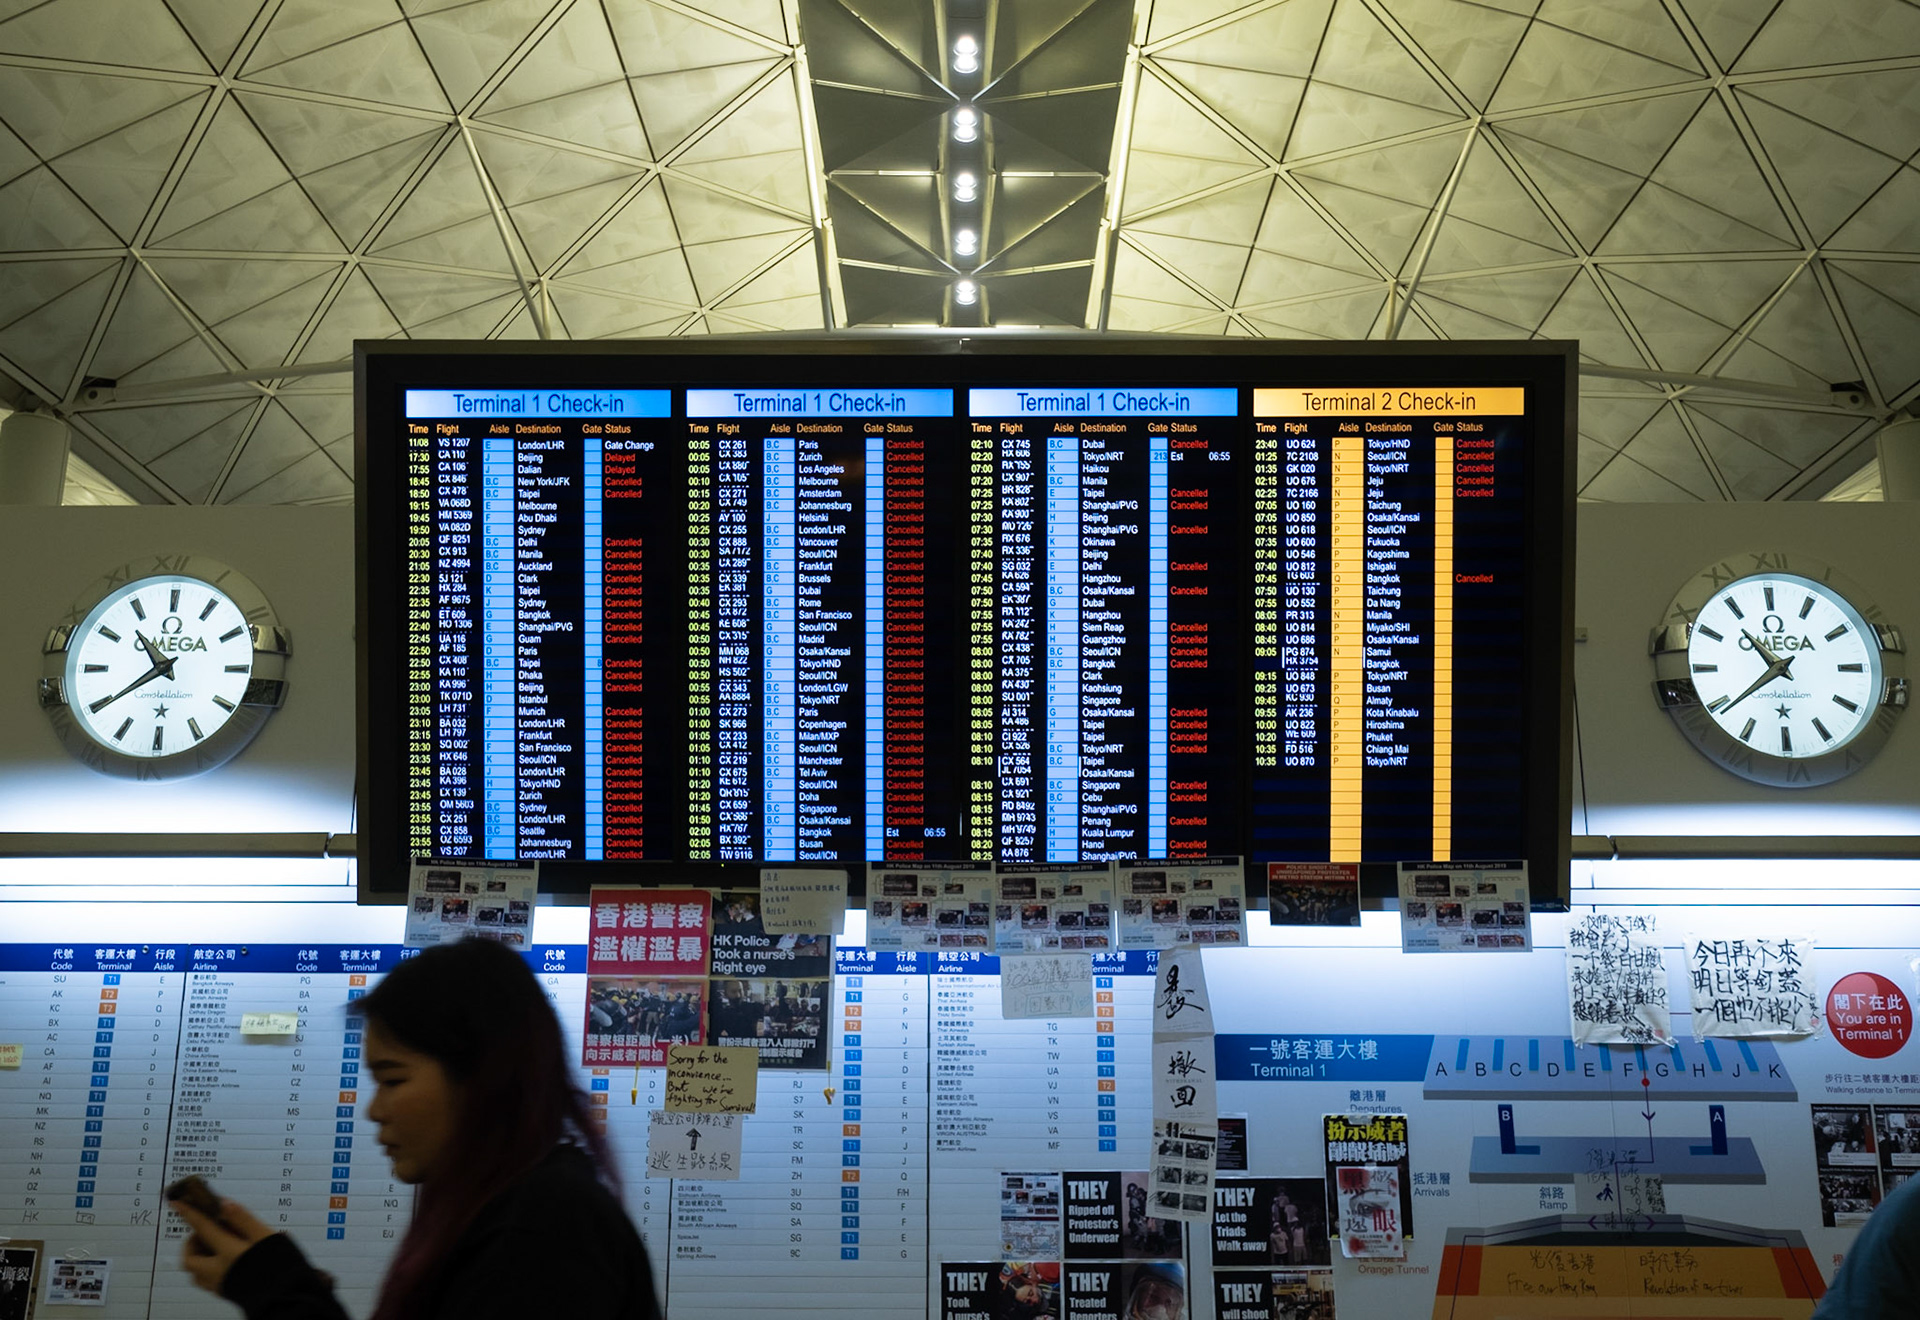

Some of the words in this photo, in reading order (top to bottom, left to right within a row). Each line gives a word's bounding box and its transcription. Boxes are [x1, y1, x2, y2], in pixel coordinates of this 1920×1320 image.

[454, 394, 525, 413] Terminal
[533, 394, 539, 412] 1
[548, 393, 624, 413] Check-in
[734, 393, 806, 412] Terminal
[814, 393, 820, 412] 1
[829, 393, 905, 412] Check-in
[1017, 393, 1090, 411] Terminal
[1098, 393, 1105, 411] 1
[1113, 392, 1190, 411] Check-in
[1302, 393, 1375, 411] Terminal
[1382, 393, 1391, 410] 2
[1399, 392, 1475, 410] Check-in
[409, 424, 428, 433] Time
[437, 424, 459, 434] Flight
[490, 425, 510, 433] Aisle
[516, 424, 561, 433] Destination
[582, 424, 602, 433] Gate
[605, 424, 631, 433] Status
[971, 440, 992, 448] 02:10
[1002, 440, 1014, 448] CX
[1016, 440, 1030, 448] 745
[1083, 440, 1105, 448] Dubai
[1171, 440, 1208, 448] Cancelled
[409, 453, 429, 462] 17:30
[439, 451, 450, 459] CA
[452, 451, 465, 459] 110
[518, 453, 543, 463] Beijing
[605, 453, 635, 463] Delayed
[689, 526, 710, 534] 00:25
[719, 526, 731, 534] CX
[733, 526, 747, 534] 255
[799, 526, 846, 534] London/LHR
[887, 526, 924, 534] Cancelled
[134, 636, 207, 652] OMEGA
[1738, 635, 1815, 651] OMEGA
[134, 689, 193, 698] Constellation
[1751, 690, 1812, 699] Constellation
[1255, 709, 1276, 717] 09:55
[1286, 709, 1297, 717] AK
[1299, 709, 1313, 717] 236
[1367, 709, 1383, 717] Kota
[1386, 709, 1418, 717] Kinabalu
[410, 815, 431, 823] 23:55
[440, 815, 452, 823] CX
[454, 815, 467, 823] 251
[519, 815, 565, 823] London/LHR
[606, 815, 642, 824] Cancelled
[596, 903, 703, 928] 香港警察
[714, 936, 732, 946] HK
[734, 935, 770, 948] Police
[53, 949, 73, 960] 代號
[95, 949, 136, 960] 客運大樓
[156, 950, 175, 960] 行段
[593, 936, 702, 961] 濫權濫暴
[712, 949, 738, 959] Took
[742, 951, 749, 959] a
[752, 949, 794, 960] nurse's
[1693, 939, 1801, 967] 今日再不來
[194, 950, 235, 960] 航空公司
[51, 962, 72, 971] Code
[97, 962, 132, 971] Terminal
[154, 962, 174, 971] Aisle
[193, 963, 217, 971] Airline
[713, 962, 743, 974] Right
[747, 964, 766, 974] eye
[1834, 994, 1903, 1011] 閣下在此
[1695, 996, 1803, 1030] 一個也不能少
[1838, 1014, 1861, 1025] You
[1866, 1015, 1886, 1024] are
[1891, 1013, 1901, 1024] in
[1047, 1023, 1057, 1031] TG
[1102, 1023, 1110, 1031] T2
[1837, 1028, 1893, 1040] Terminal
[1898, 1029, 1902, 1040] 1
[586, 1049, 663, 1060] 向示威者開槍
[1250, 1040, 1378, 1060] 一號客運大樓
[670, 1046, 694, 1069] Sorry
[696, 1051, 709, 1064] for
[714, 1052, 727, 1063] the
[1251, 1064, 1313, 1076] Terminal
[1320, 1065, 1326, 1076] 1
[1436, 1062, 1447, 1076] A
[1475, 1063, 1486, 1076] B
[1510, 1063, 1522, 1076] C
[1548, 1063, 1560, 1076] D
[1585, 1063, 1593, 1077] E
[1625, 1063, 1633, 1076] F
[1656, 1063, 1668, 1077] G
[1694, 1064, 1704, 1077] H
[1733, 1064, 1740, 1077] J
[1769, 1064, 1781, 1077] K
[668, 1082, 689, 1092] But
[1826, 1086, 1854, 1095] Walking
[1856, 1086, 1886, 1094] distance
[667, 1094, 702, 1108] fighting
[706, 1094, 717, 1104] for
[1350, 1090, 1386, 1102] 離港層
[1350, 1104, 1402, 1113] Departures
[1328, 1123, 1404, 1141] 扮示威者
[1413, 1173, 1450, 1185] 抵港層
[791, 1188, 801, 1196] 3U
[846, 1188, 855, 1196] T1
[1068, 1181, 1108, 1199] THEY
[1414, 1188, 1450, 1197] Arrivals
[1539, 1187, 1564, 1199] 斜路
[1215, 1188, 1255, 1206] THEY
[1069, 1205, 1100, 1217] Ripped
[1103, 1205, 1114, 1215] off
[1539, 1200, 1568, 1211] Ramp
[1216, 1212, 1229, 1223] Let
[1231, 1212, 1246, 1223] the
[1069, 1219, 1118, 1231] Protestor's
[1216, 1226, 1246, 1237] Triads
[1069, 1233, 1119, 1243] Underwear
[1217, 1241, 1239, 1251] Walk
[1241, 1241, 1267, 1253] away
[1358, 1265, 1394, 1276] Orange
[1398, 1265, 1429, 1274] Tunnel
[947, 1273, 988, 1291] THEY
[1069, 1273, 1110, 1291] THEY
[1222, 1284, 1262, 1303] THEY
[947, 1297, 970, 1308] Took
[1070, 1298, 1106, 1308] Treated
[1223, 1309, 1240, 1320] will
[1243, 1309, 1268, 1319] shoot
